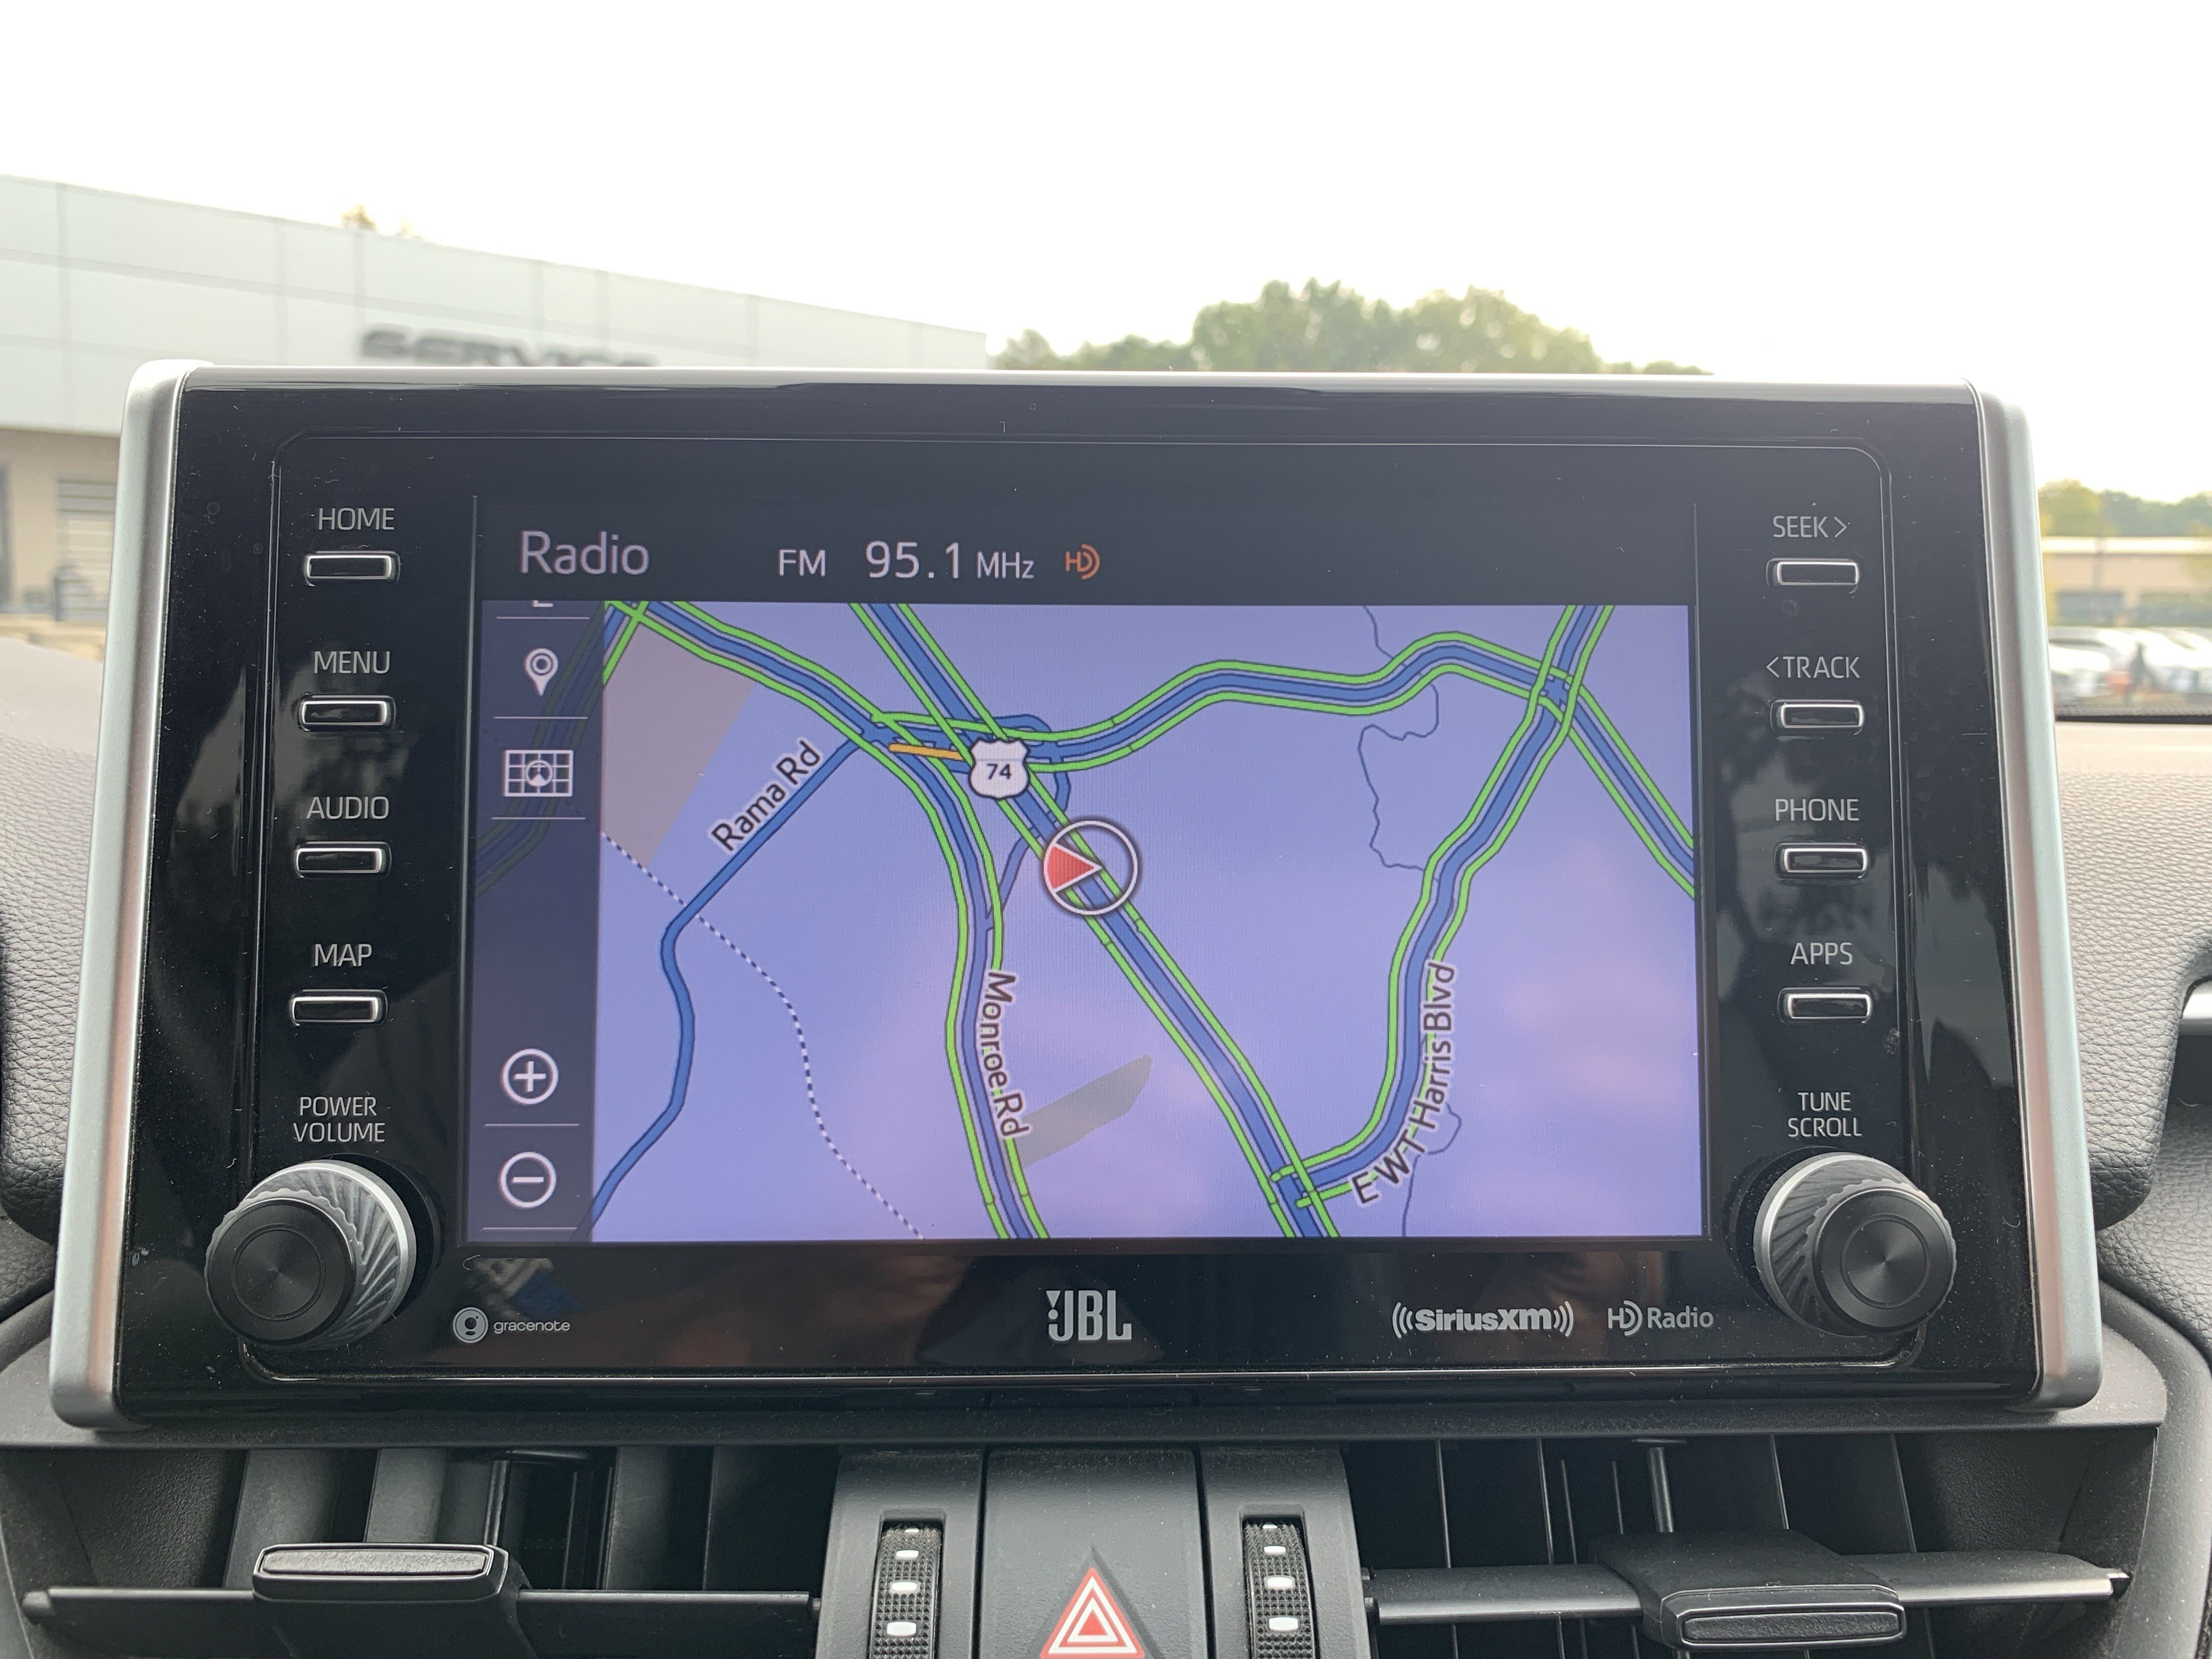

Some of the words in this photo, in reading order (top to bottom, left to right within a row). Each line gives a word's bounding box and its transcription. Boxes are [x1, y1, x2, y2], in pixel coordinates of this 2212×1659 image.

[318, 507, 395, 531] HOME
[1773, 516, 1829, 538] SEEK
[519, 530, 651, 575] Radio
[778, 550, 827, 576] FM
[865, 540, 961, 579] 95.1
[977, 552, 1035, 579] MHz
[314, 651, 391, 674] MENU
[1783, 657, 1860, 679] TRACK
[986, 763, 1012, 780] 74
[712, 781, 786, 851] Rama
[776, 740, 821, 785] Rd
[306, 797, 390, 819] AUDIO
[1775, 799, 1859, 821] PHONE
[314, 944, 373, 967] MAP
[1790, 943, 1853, 965] APPS
[1423, 961, 1455, 1031] Blvd
[979, 972, 1017, 1088] Monroe
[1408, 1041, 1452, 1129] Harris
[300, 1097, 377, 1116] POWER
[1798, 1092, 1851, 1111] TUNE
[994, 1092, 1030, 1137] Rd
[294, 1122, 386, 1143] VOLUME
[1788, 1118, 1862, 1137] SCROLL
[1352, 1171, 1379, 1204] E
[1046, 1290, 1132, 1341] JBL
[1647, 1307, 1714, 1329] Radio
[494, 1320, 571, 1334] gracenote
